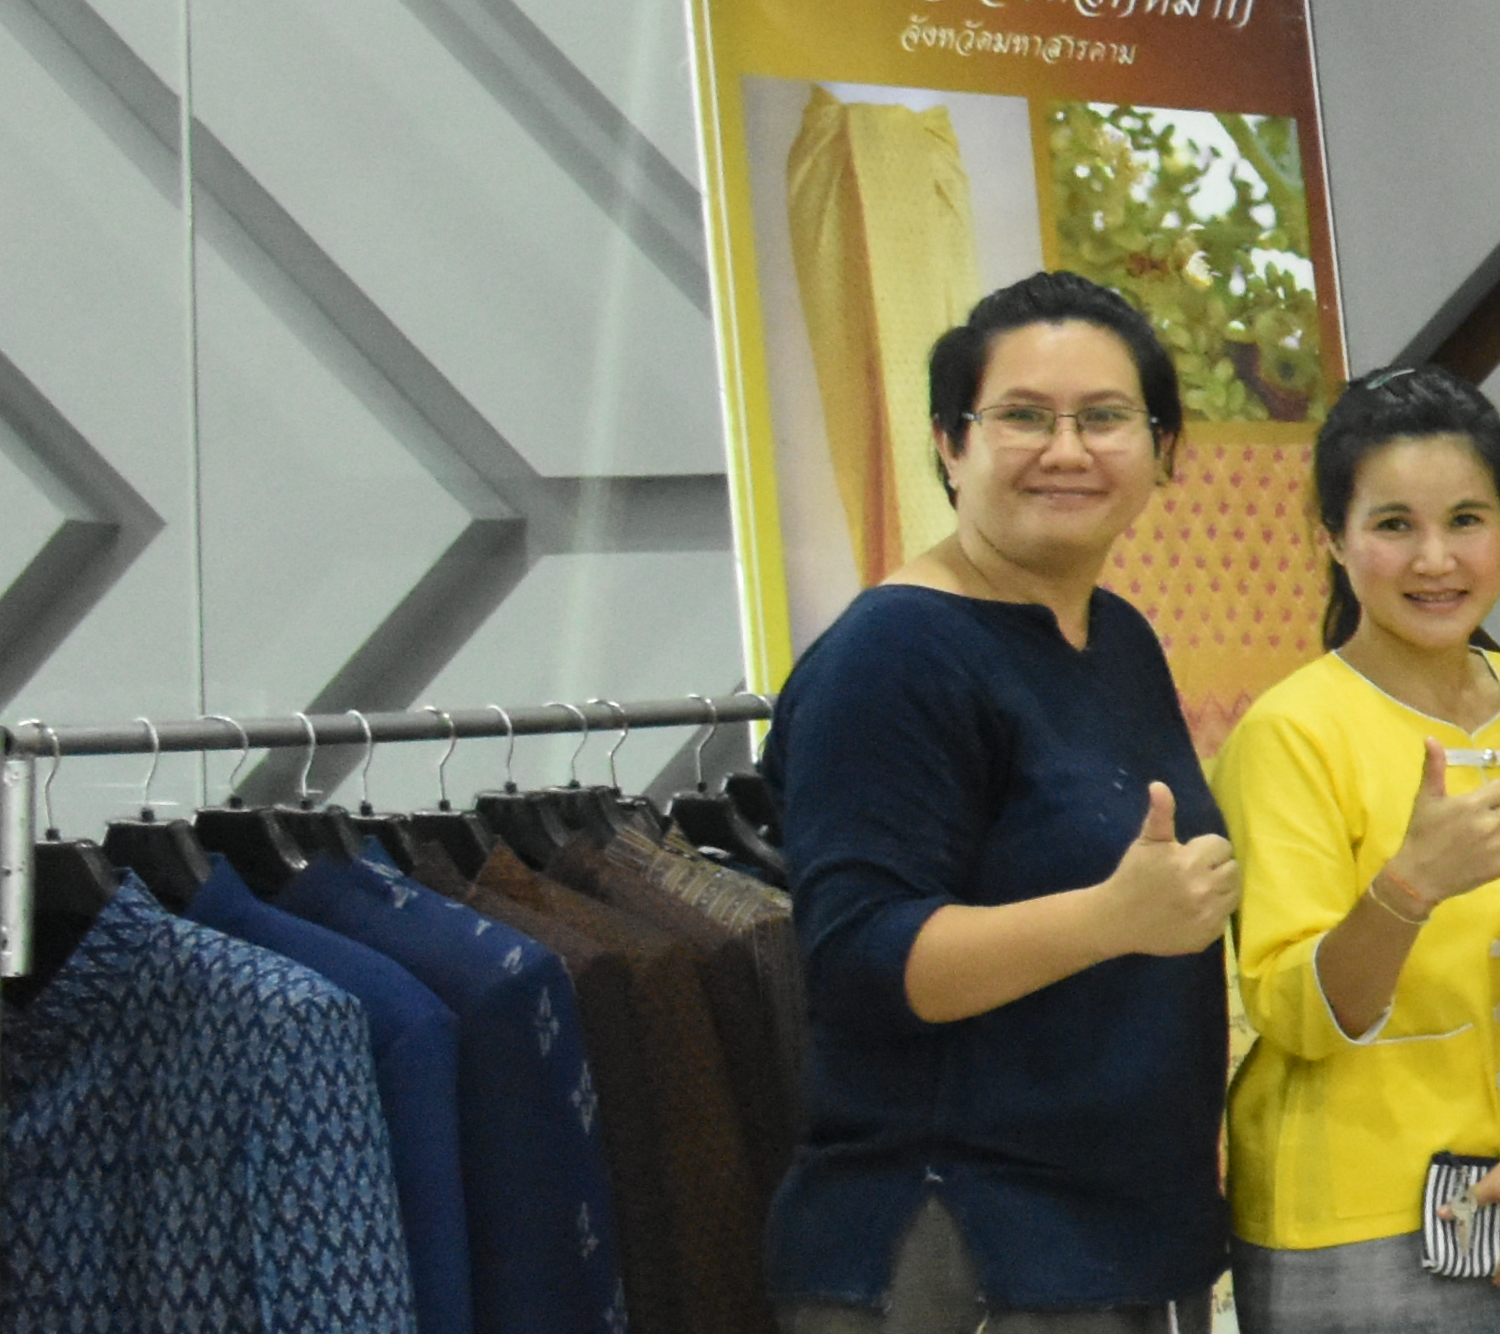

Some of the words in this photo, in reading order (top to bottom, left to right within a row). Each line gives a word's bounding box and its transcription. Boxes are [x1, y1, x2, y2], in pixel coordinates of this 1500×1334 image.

[901, 13, 1138, 66] จังหวัดมหาสารคาม
